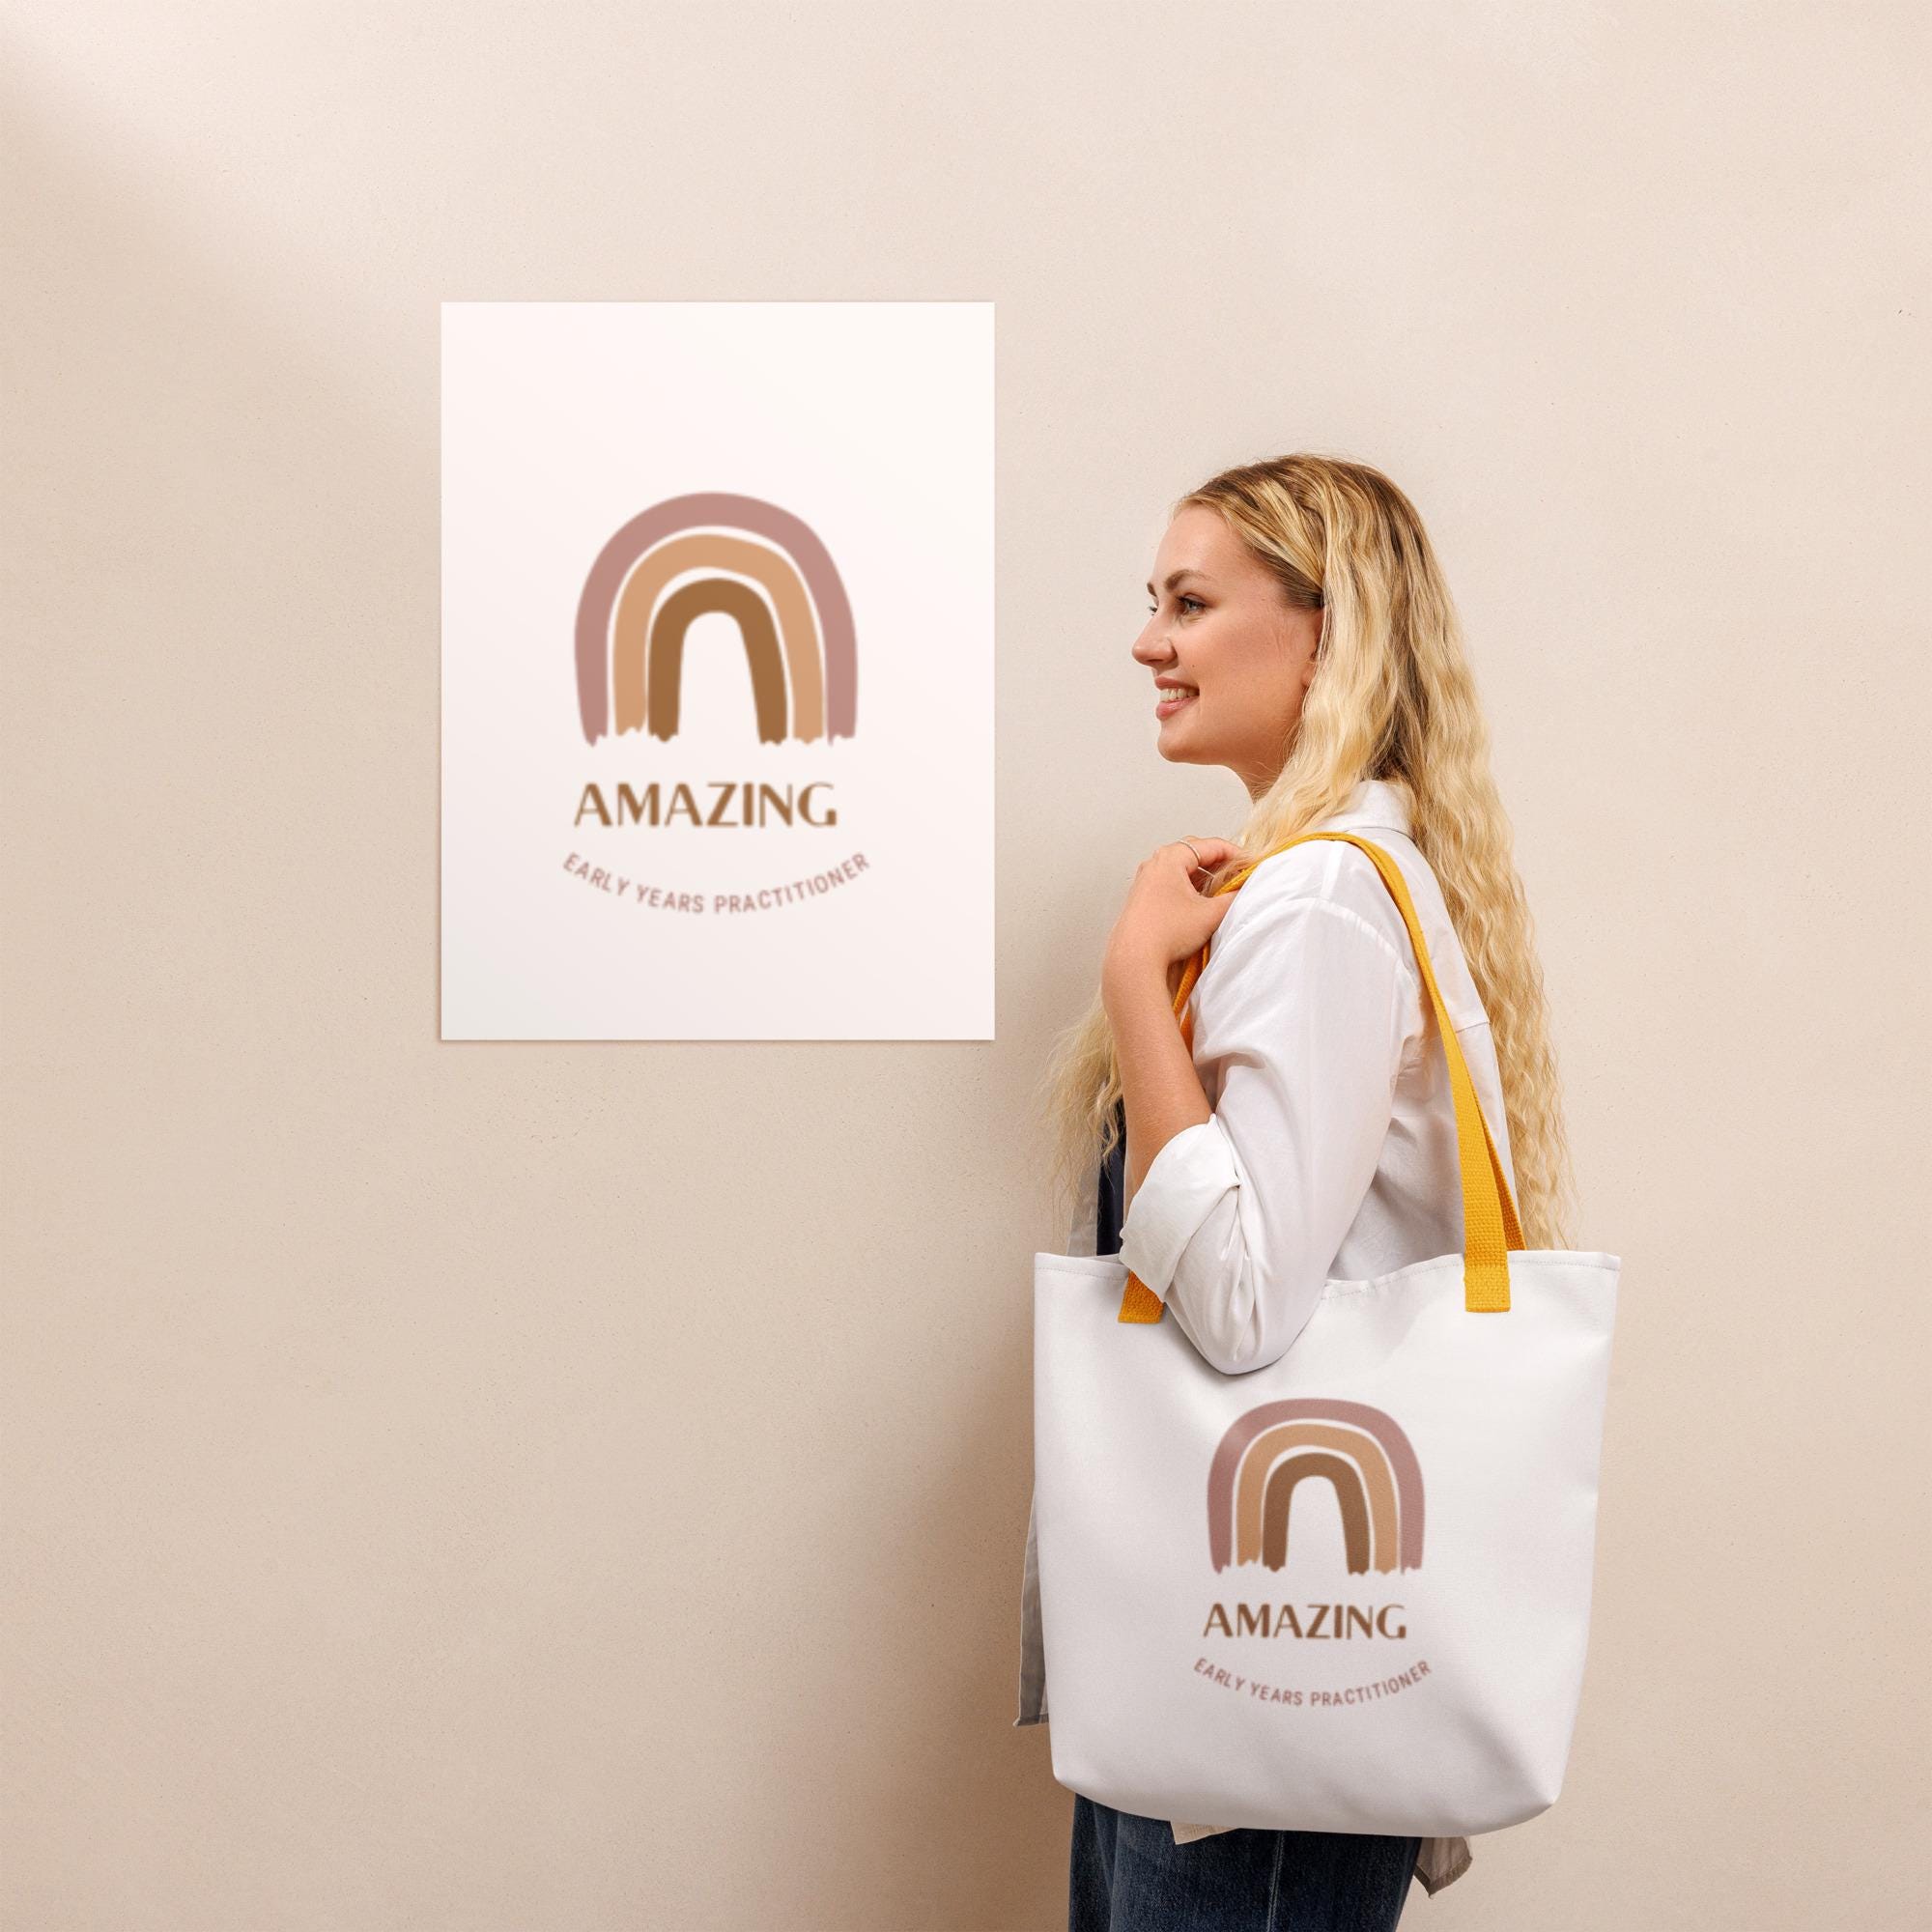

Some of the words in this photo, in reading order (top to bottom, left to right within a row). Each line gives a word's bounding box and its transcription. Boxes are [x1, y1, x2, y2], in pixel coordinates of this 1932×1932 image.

[574, 781, 838, 828] AMAZING
[562, 852, 630, 896] EARLY
[636, 883, 705, 915] YEARS
[715, 851, 871, 915] PRACTITIONER
[1203, 1602, 1407, 1640] AMAZING
[1193, 1658, 1245, 1691] EARLY
[1250, 1681, 1303, 1707] YEARS
[1311, 1660, 1433, 1707] PRACTITIONER
